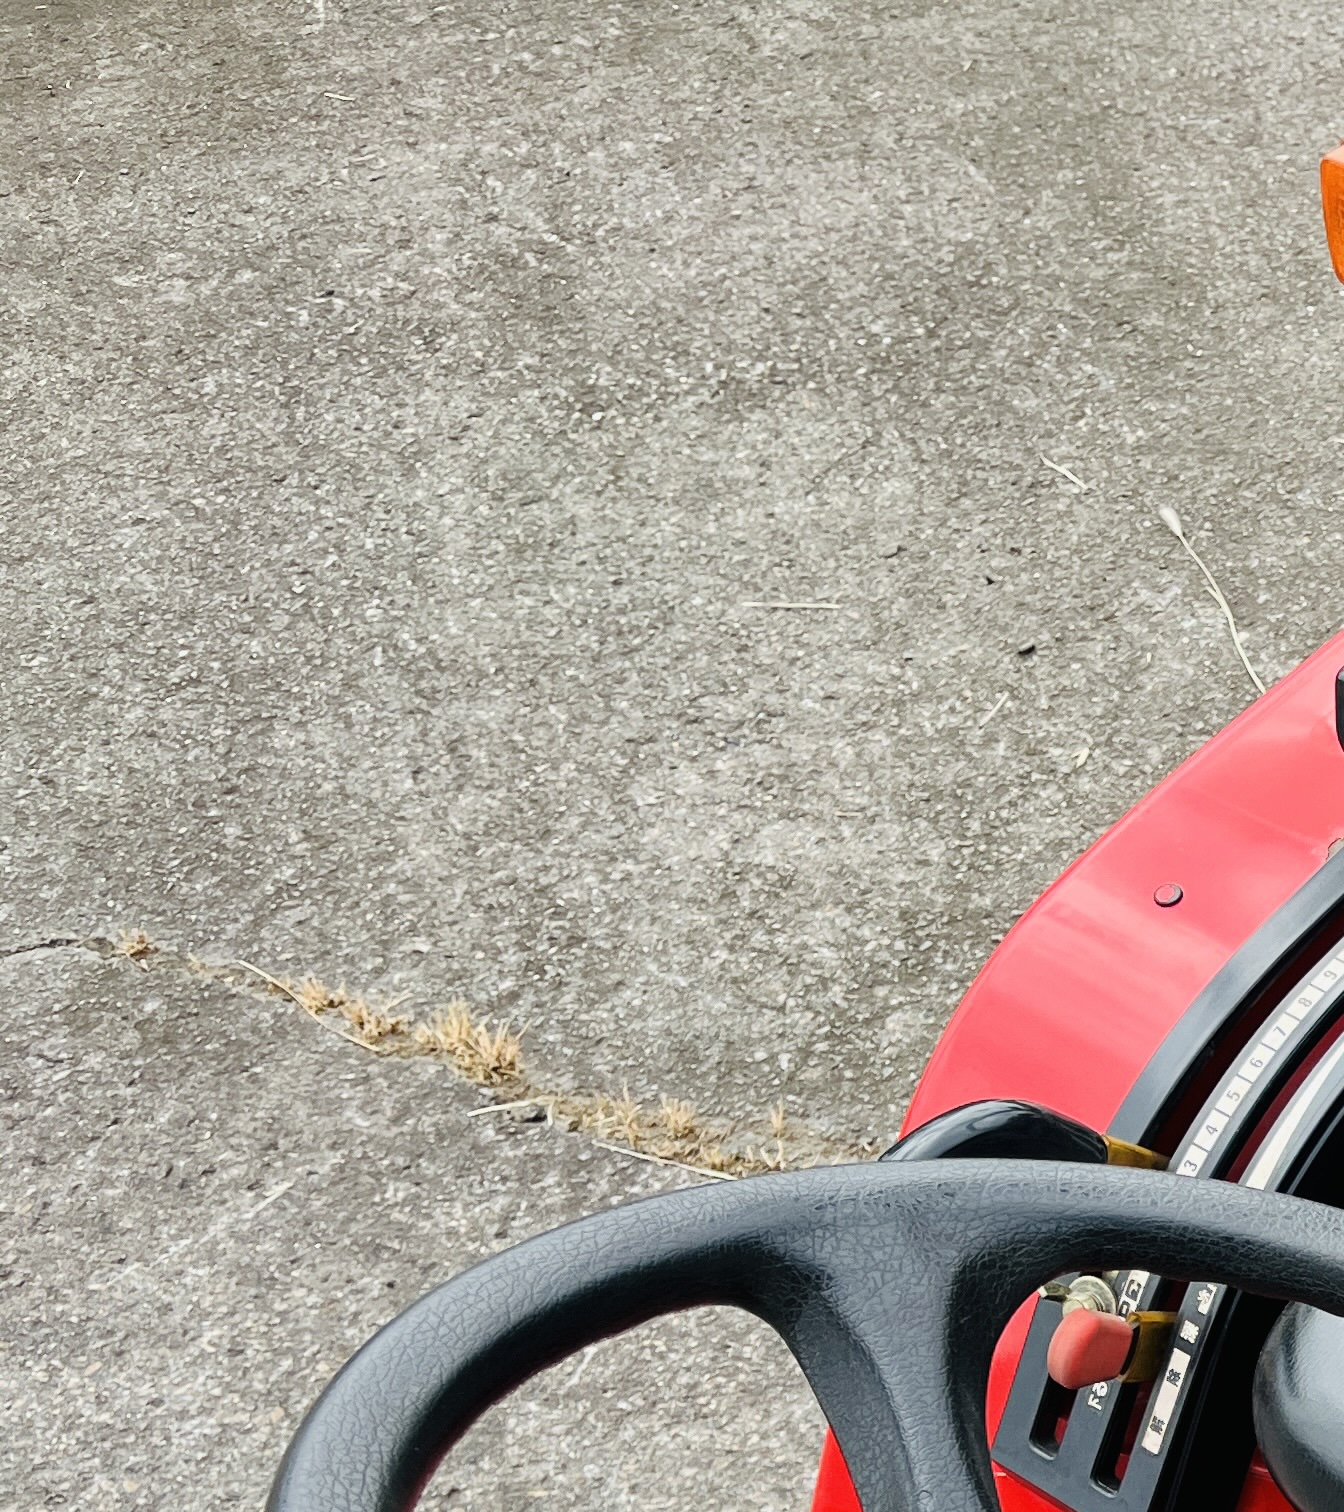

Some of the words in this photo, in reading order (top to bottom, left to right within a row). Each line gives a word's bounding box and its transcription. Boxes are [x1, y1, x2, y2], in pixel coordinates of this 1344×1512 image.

[1324, 969, 1339, 982] 9
[1299, 997, 1313, 1009] 8
[1273, 1026, 1287, 1038] 7
[1249, 1057, 1264, 1069] 6
[1226, 1091, 1241, 1102] 5
[1205, 1124, 1218, 1137] 4
[1184, 1159, 1198, 1173] 3
